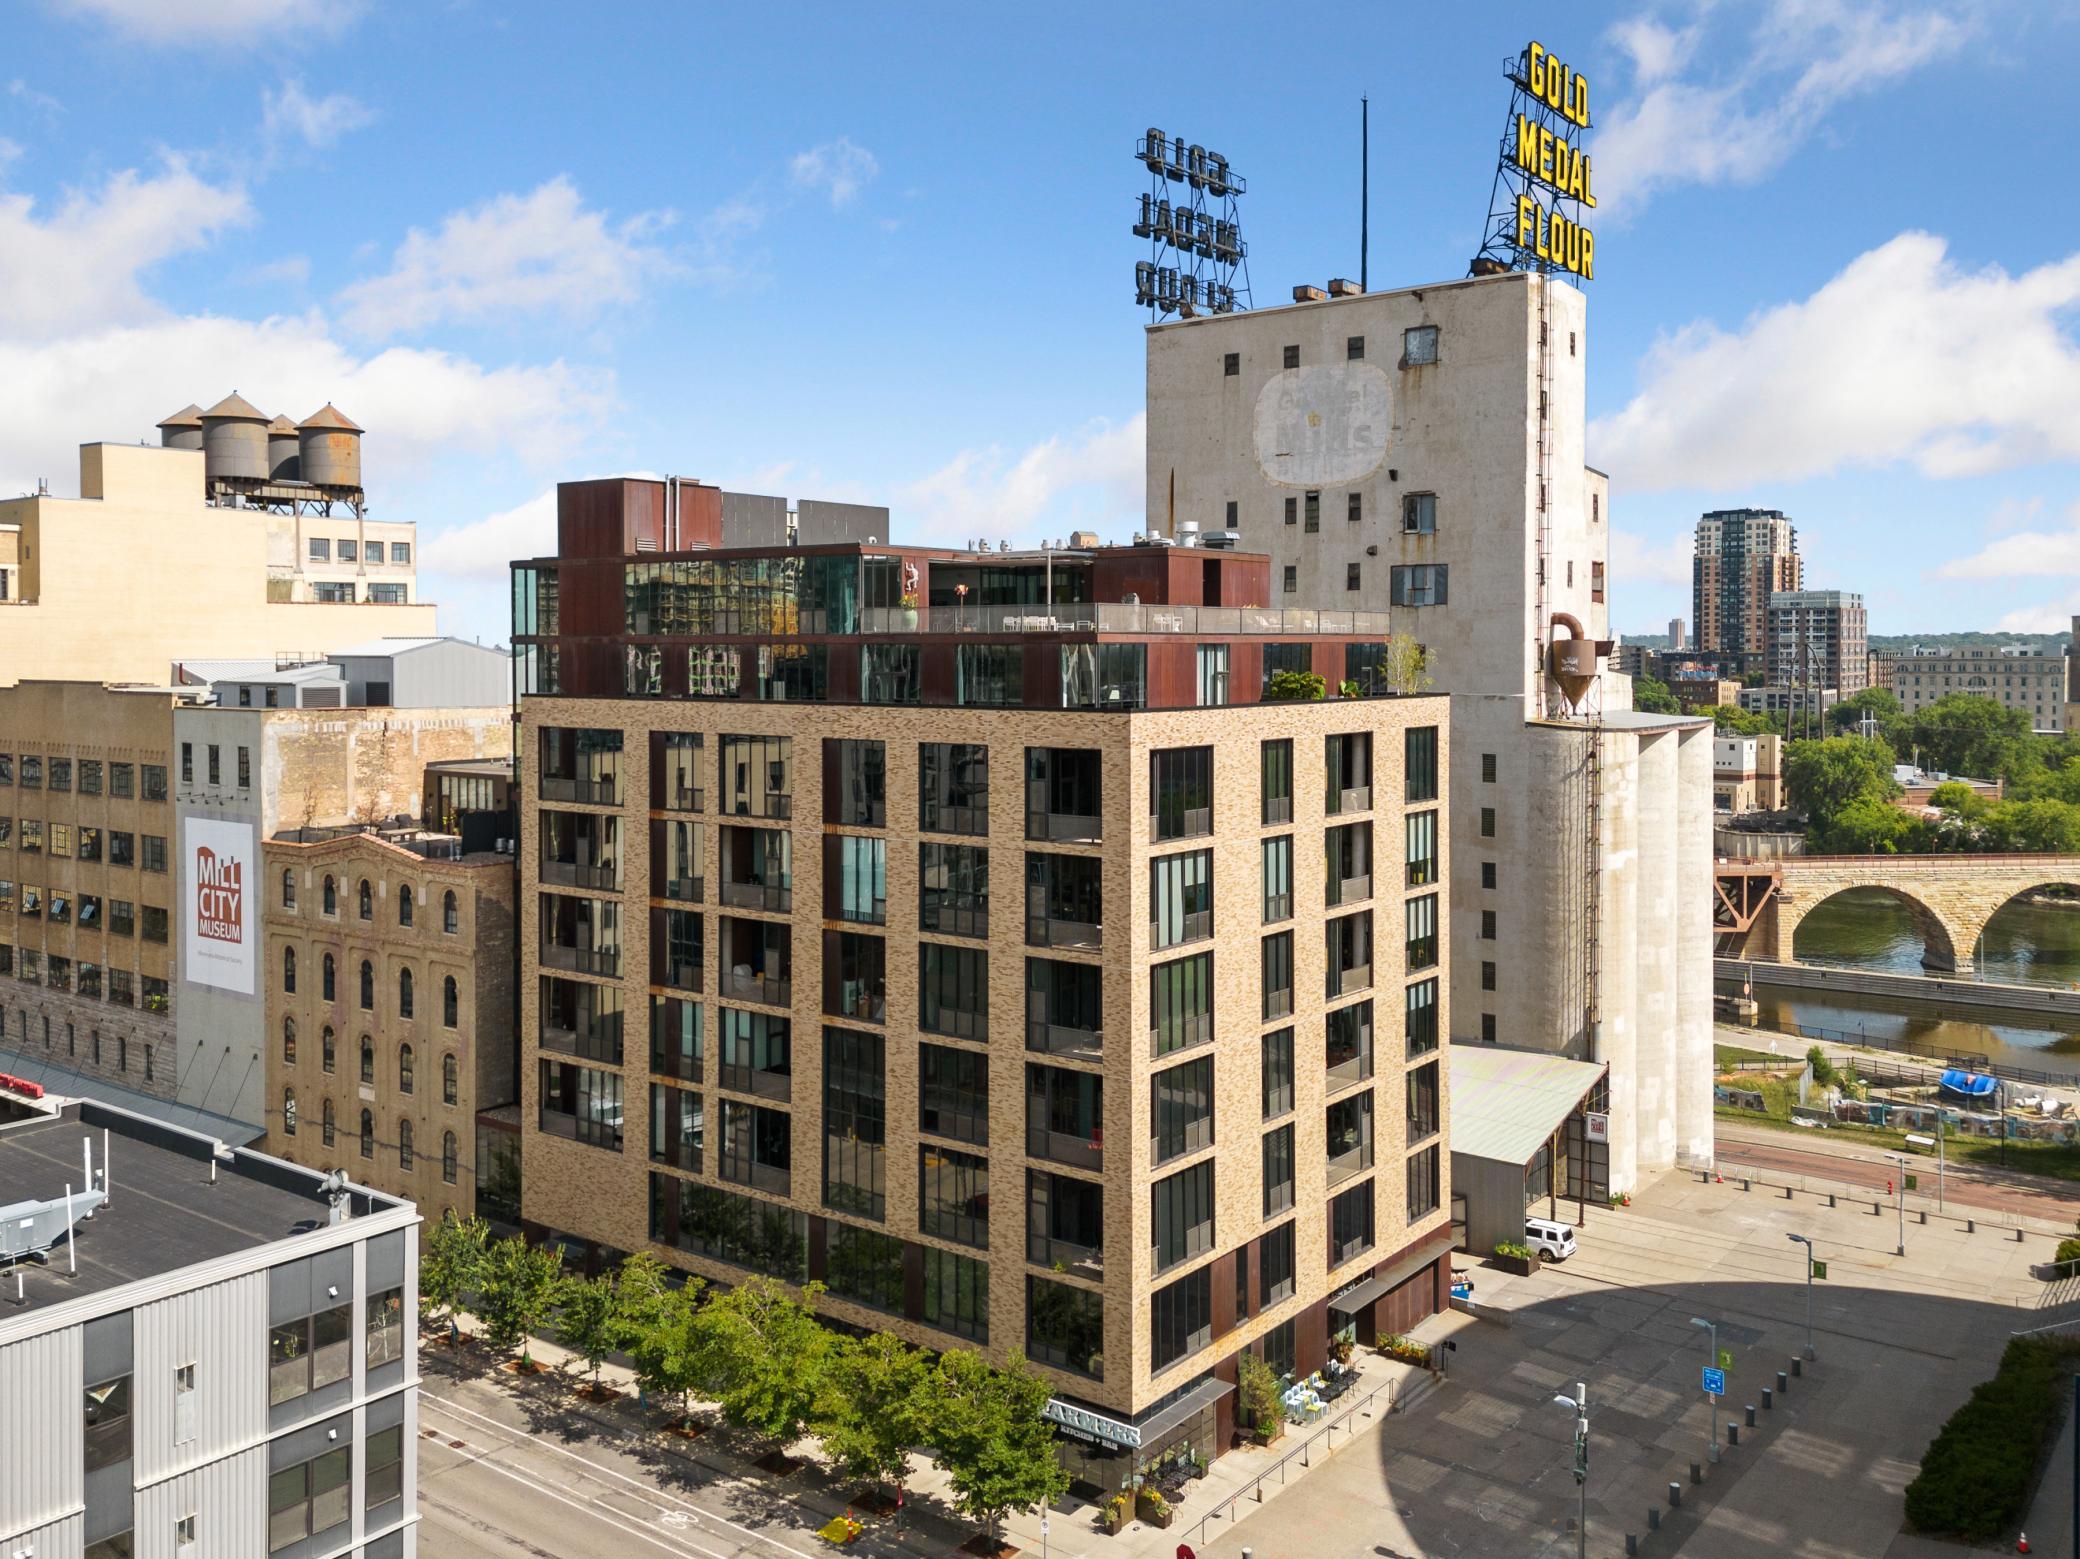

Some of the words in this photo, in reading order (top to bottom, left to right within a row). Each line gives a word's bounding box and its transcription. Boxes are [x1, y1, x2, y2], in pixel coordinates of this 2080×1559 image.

[1527, 40, 1589, 128] GOLD
[1516, 113, 1597, 208] MEDAL
[1516, 194, 1594, 280] FLOUR
[199, 855, 240, 889] MILL
[199, 887, 240, 921] CITY
[199, 919, 240, 940] MUSEUM
